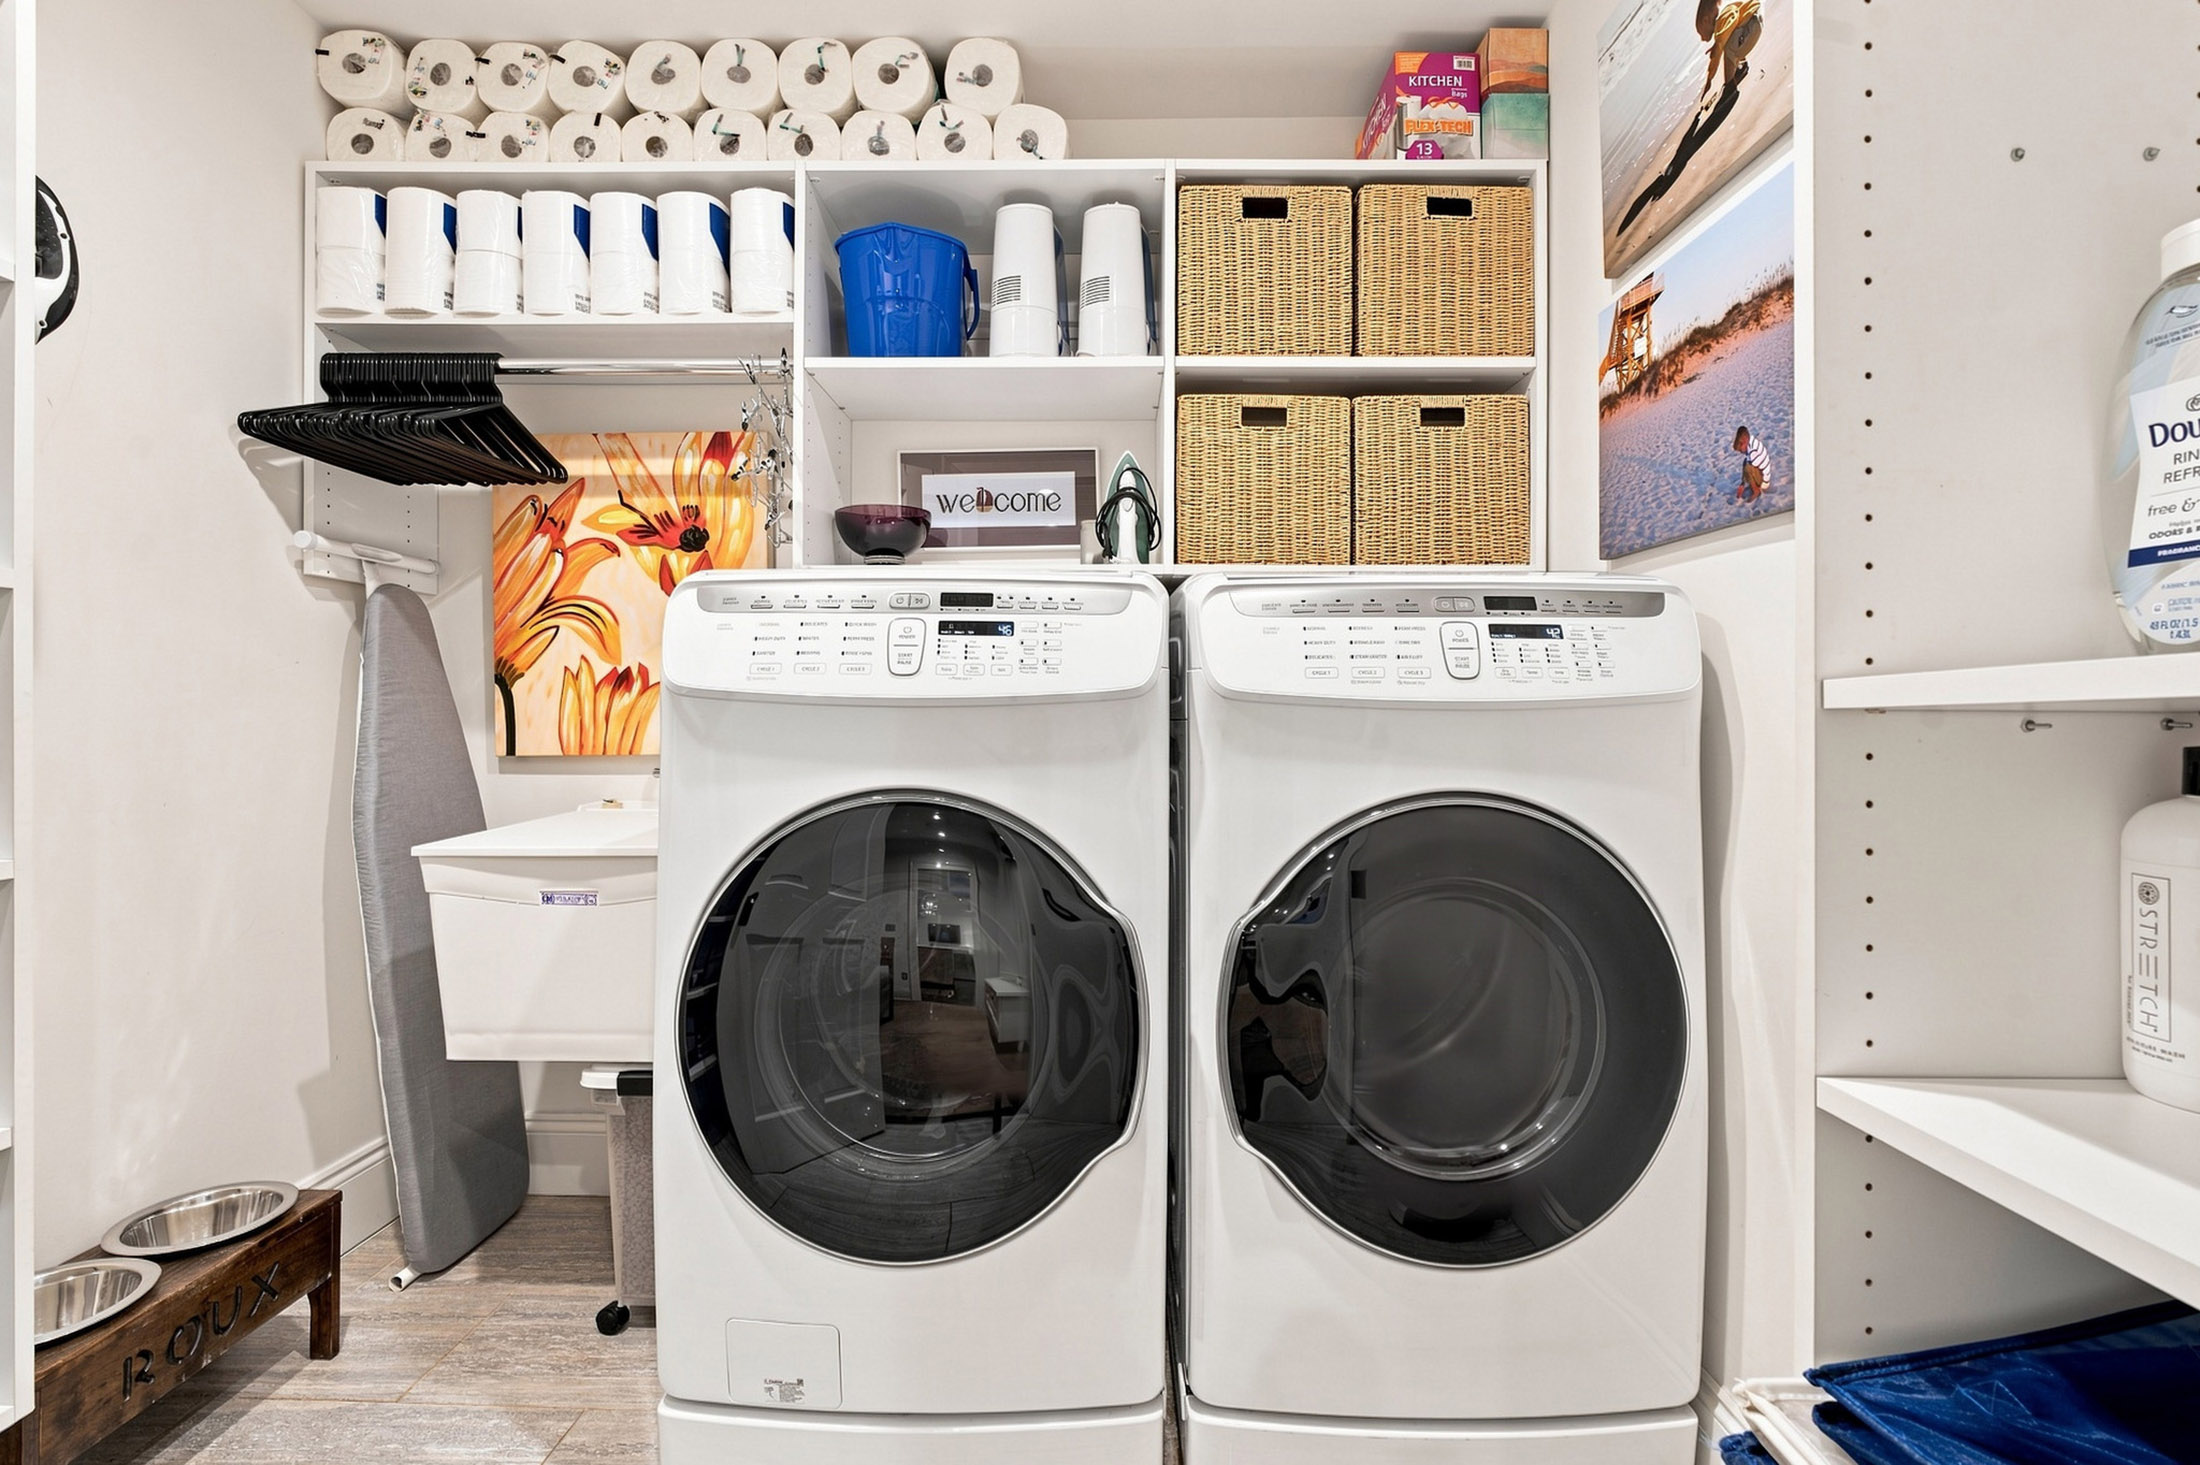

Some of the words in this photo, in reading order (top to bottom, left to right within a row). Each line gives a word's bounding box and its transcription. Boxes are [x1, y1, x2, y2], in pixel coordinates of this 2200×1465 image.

[1408, 75, 1463, 87] KITCHEN
[1451, 90, 1468, 99] Bags
[1416, 142, 1433, 155] 13
[935, 486, 1062, 514] welcome
[2147, 503, 2178, 517] free
[121, 1260, 280, 1403] ROUX
